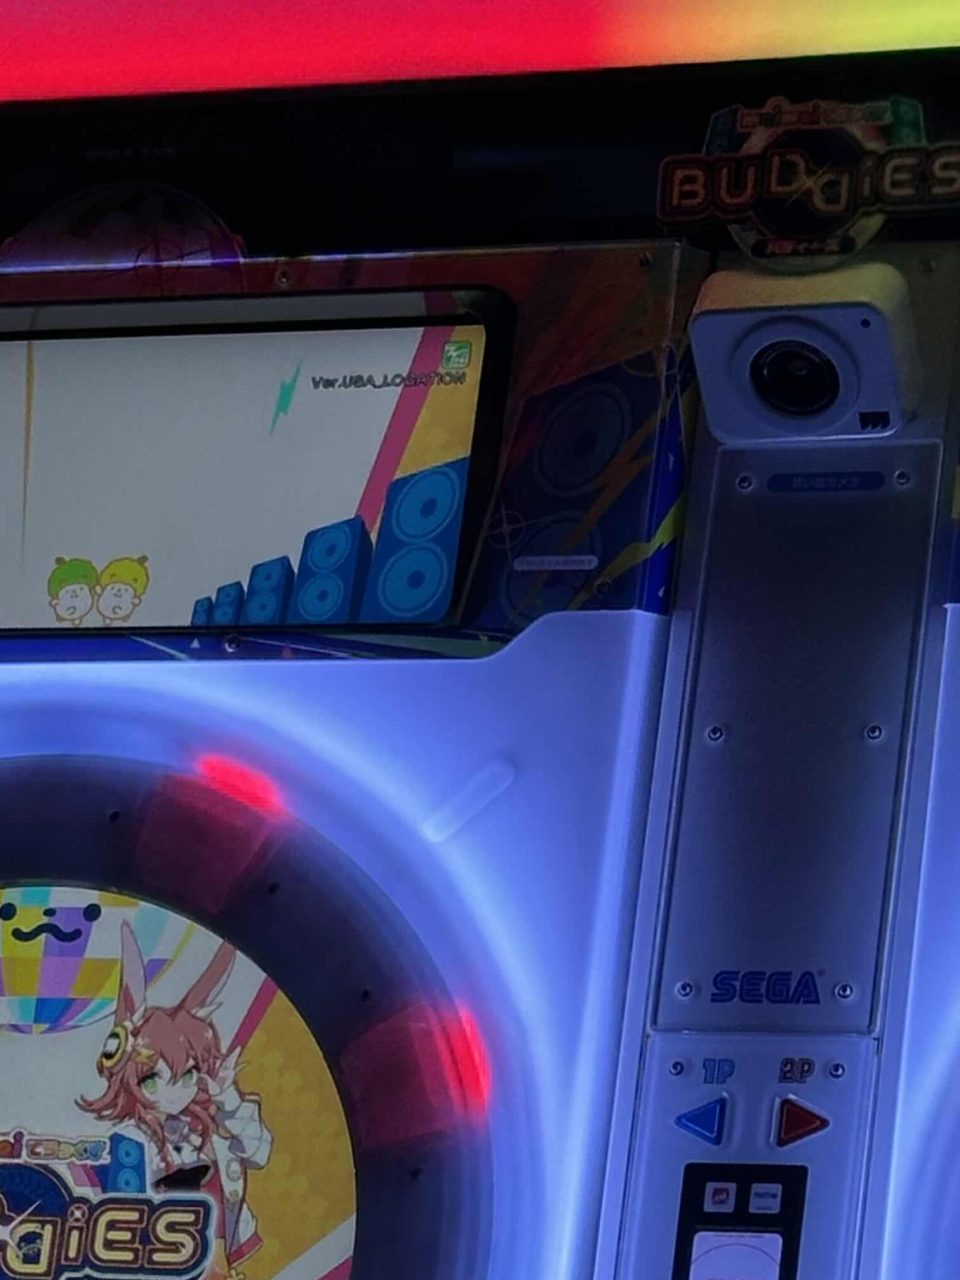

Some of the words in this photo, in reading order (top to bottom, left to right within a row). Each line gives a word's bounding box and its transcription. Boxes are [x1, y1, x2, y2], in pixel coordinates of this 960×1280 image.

[711, 970, 821, 1005] SEGA
[703, 1058, 736, 1085] 1P
[778, 1057, 816, 1084] 2P
